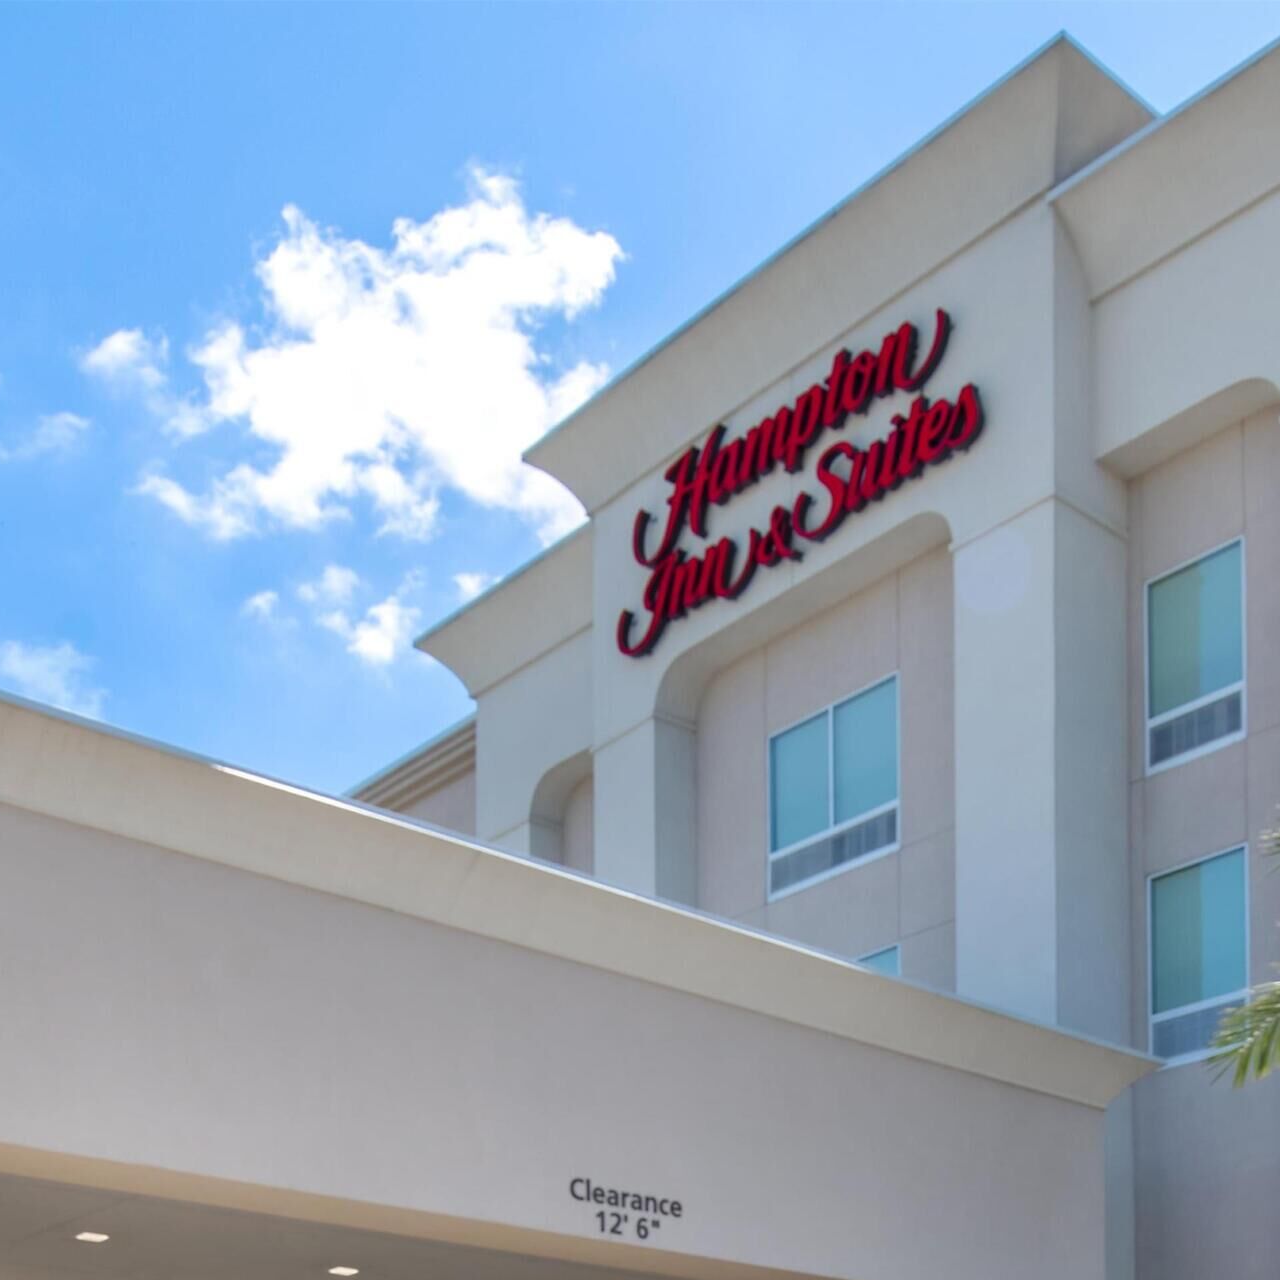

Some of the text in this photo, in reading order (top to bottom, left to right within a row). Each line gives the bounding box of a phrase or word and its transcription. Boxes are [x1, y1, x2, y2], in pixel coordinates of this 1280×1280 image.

[633, 308, 950, 567] Hampton
[617, 383, 984, 656] Inn & Suites
[569, 1177, 683, 1218] Clearance
[595, 1210, 661, 1240] 12' 6"
